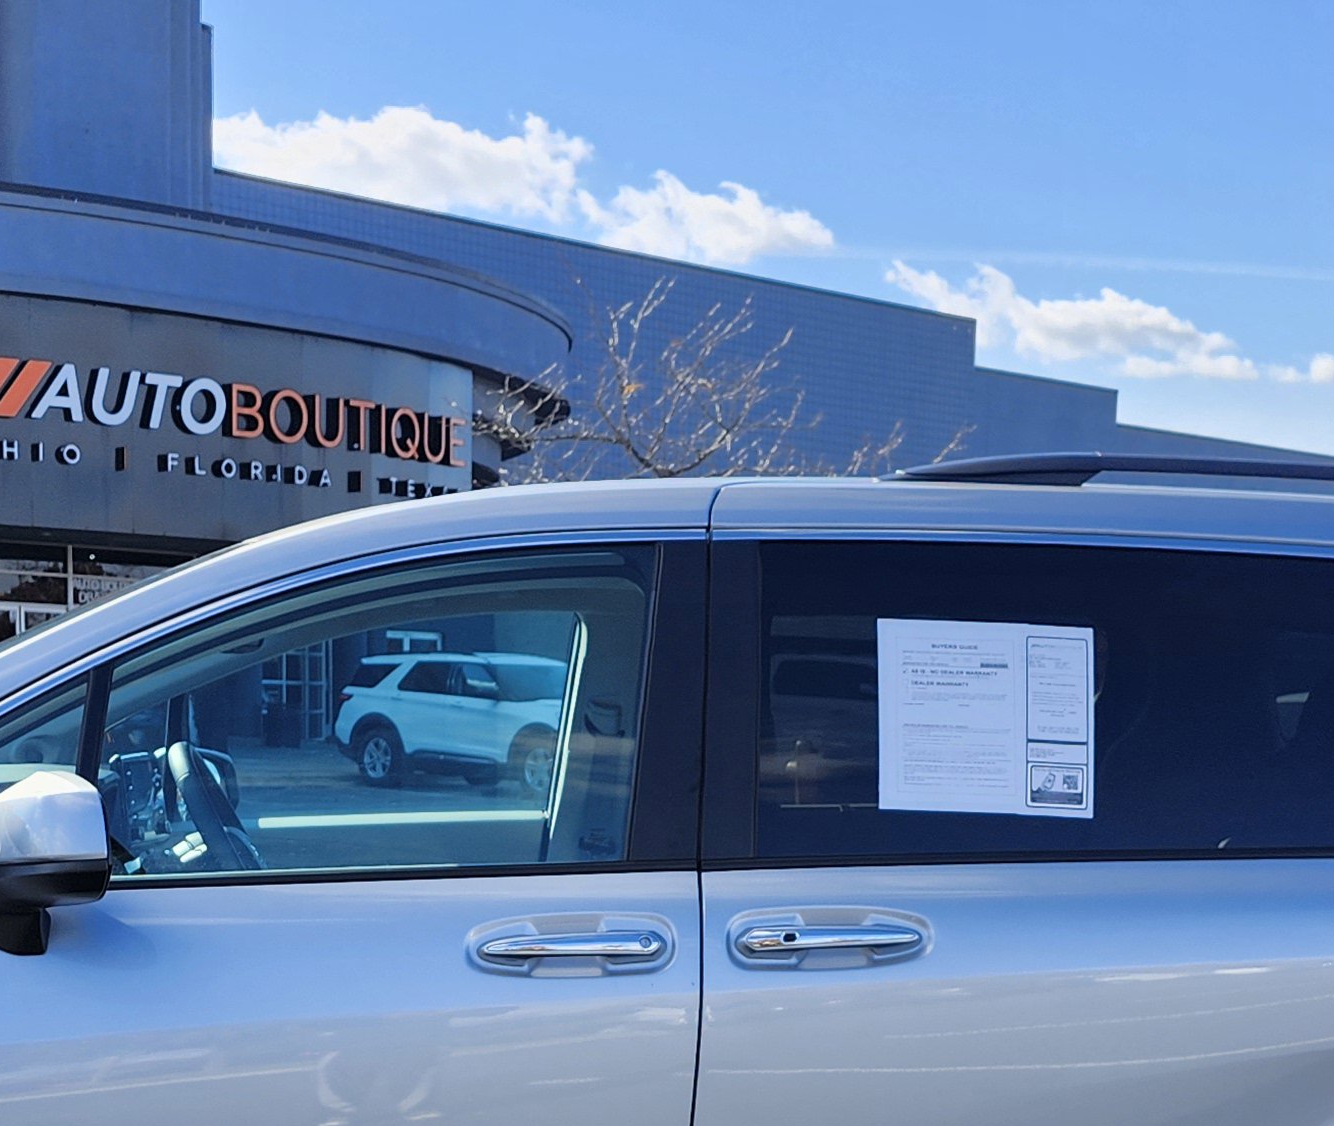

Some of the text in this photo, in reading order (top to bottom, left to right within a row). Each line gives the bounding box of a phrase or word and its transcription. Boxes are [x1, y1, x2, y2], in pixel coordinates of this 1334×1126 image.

[29, 362, 466, 467] AUTOBOUTIQUE
[167, 452, 332, 487] FLORIDA
[389, 476, 462, 498] TEX
